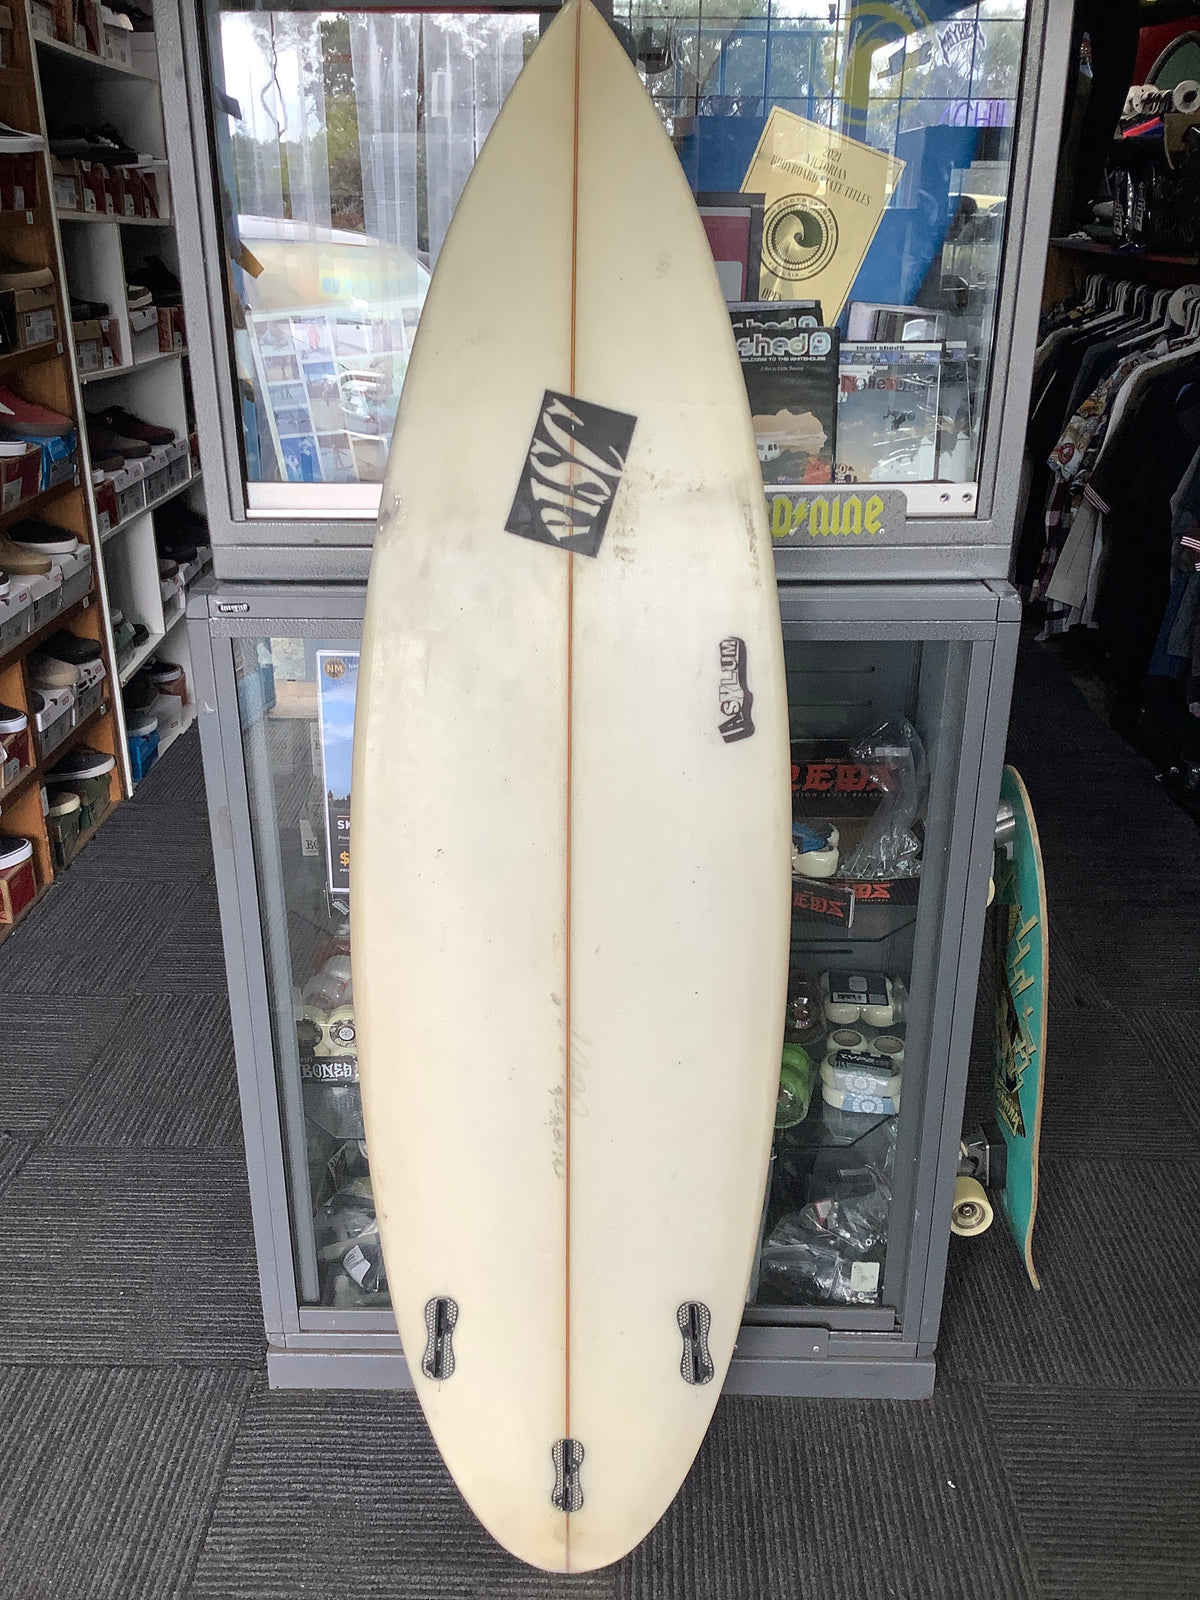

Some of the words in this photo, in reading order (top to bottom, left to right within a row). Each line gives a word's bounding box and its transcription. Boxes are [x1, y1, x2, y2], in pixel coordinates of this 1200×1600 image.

[805, 153, 848, 180] VICTORIAN
[823, 146, 842, 163] 2021
[770, 154, 819, 184] BODYBOARD
[844, 186, 872, 207] TITLES
[776, 197, 835, 232] BODYBOADING
[737, 332, 832, 356] shed9
[718, 637, 751, 743] ASYLUM
[301, 1062, 352, 1078] BONES
